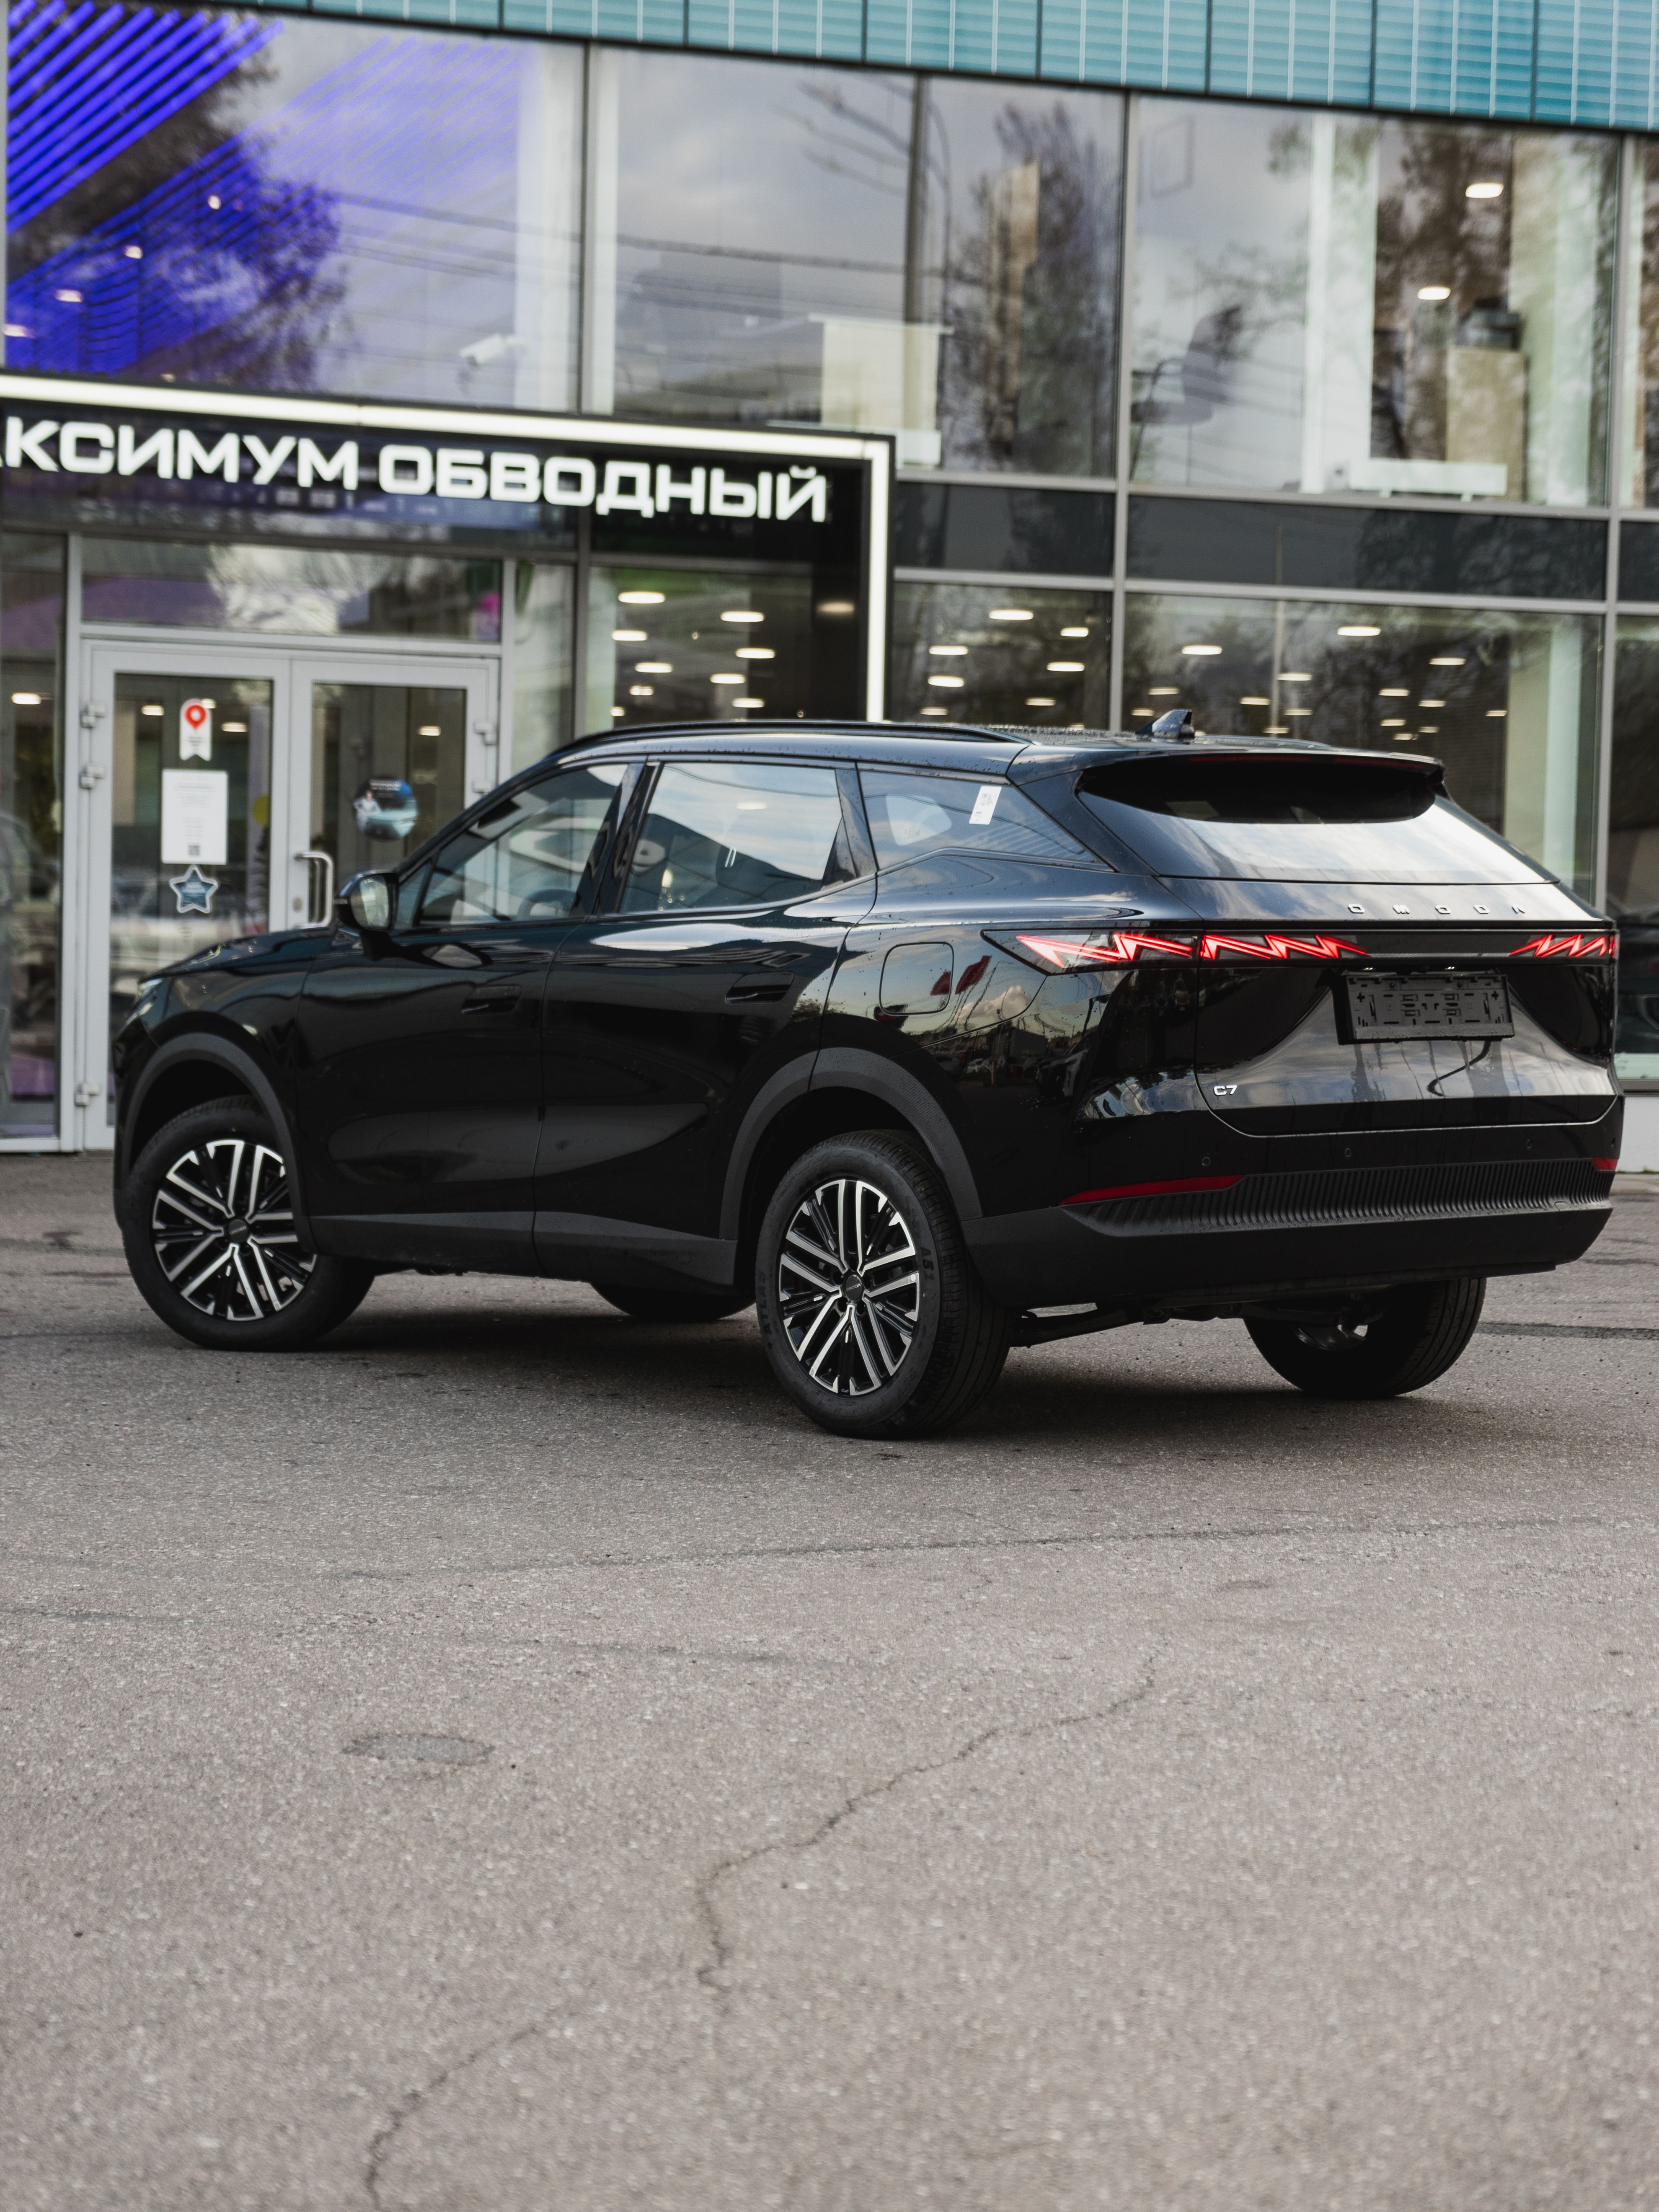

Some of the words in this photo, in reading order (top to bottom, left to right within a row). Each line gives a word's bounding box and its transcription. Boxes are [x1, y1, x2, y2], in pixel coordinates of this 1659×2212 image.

[0, 416, 359, 491] КСИМУМ
[378, 444, 827, 523] ОБВОДНЫЙ
[1213, 1085, 1238, 1096] C7
[921, 1248, 935, 1281] A51
[758, 1271, 772, 1335] ATLAS
